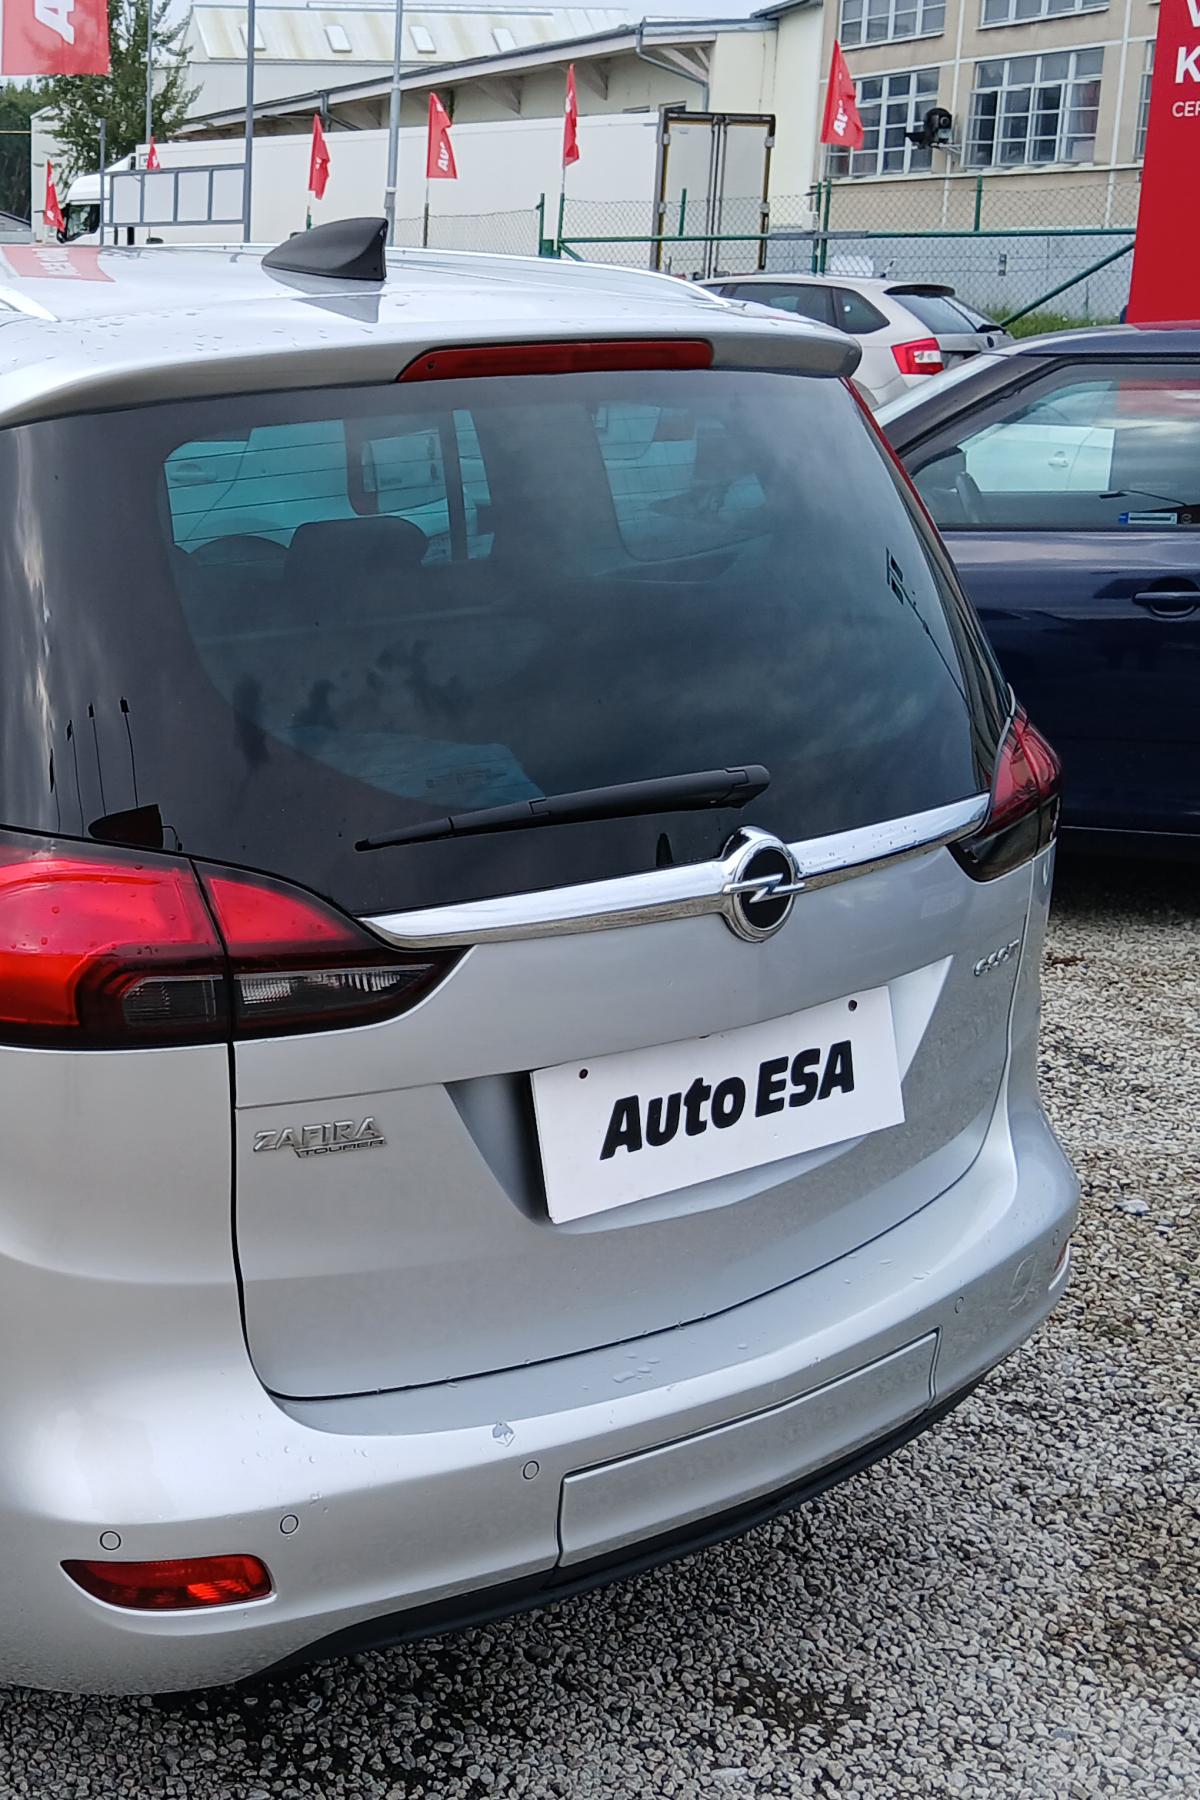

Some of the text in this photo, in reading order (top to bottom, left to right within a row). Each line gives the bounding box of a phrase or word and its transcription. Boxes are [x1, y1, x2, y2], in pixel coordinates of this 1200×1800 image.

[599, 1039, 855, 1161] Auto ESA
[253, 1116, 382, 1152] ZAFIRA
[301, 1139, 385, 1157] TOURER
